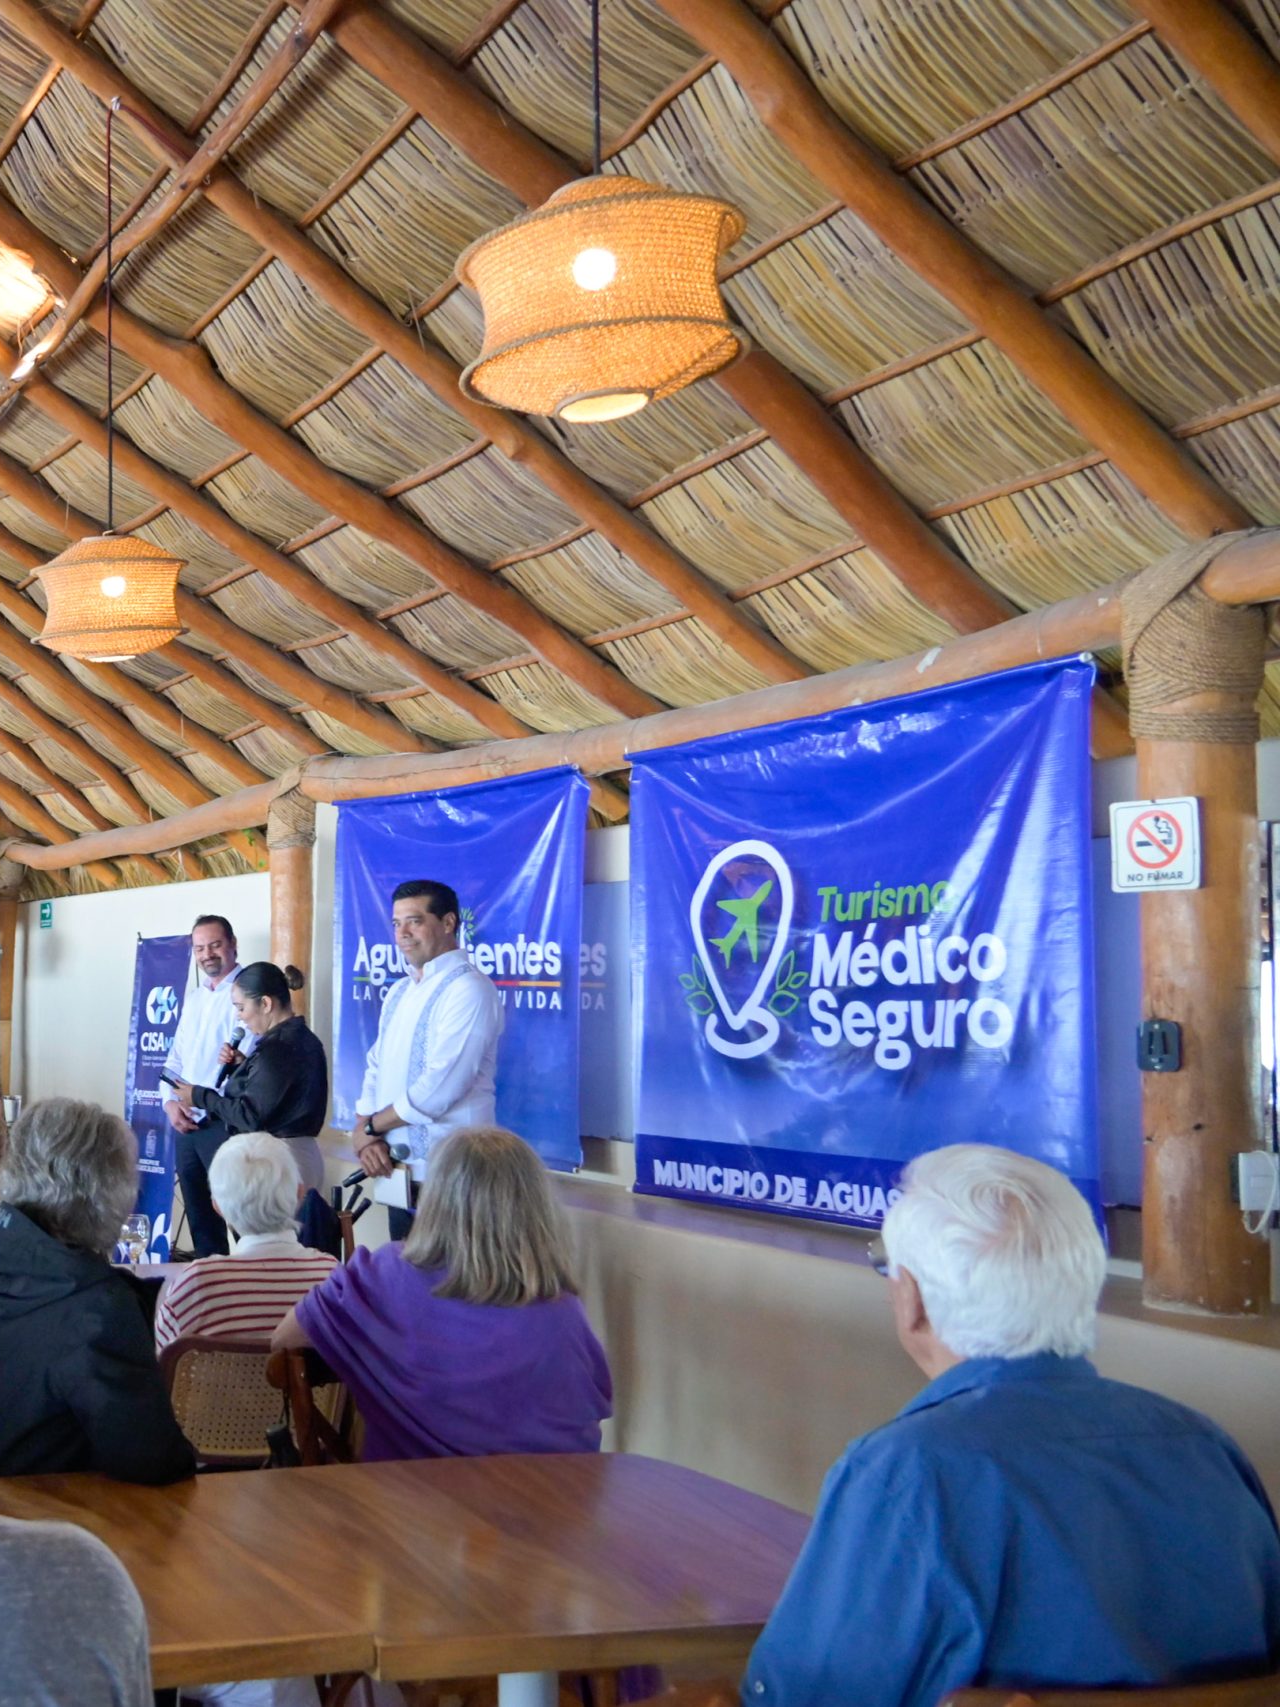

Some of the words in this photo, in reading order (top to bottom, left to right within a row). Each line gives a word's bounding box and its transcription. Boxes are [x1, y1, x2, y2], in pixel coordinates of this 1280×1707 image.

[1127, 873, 1144, 882] NO
[1147, 870, 1184, 881] FUMAR
[816, 880, 954, 923] Turismo
[809, 922, 1008, 988] Médico
[352, 984, 372, 1001] LA
[514, 990, 562, 1011] VIDA
[808, 988, 1014, 1070] Seguro
[652, 1158, 770, 1200] MUNICIPIO
[773, 1173, 808, 1207] DE
